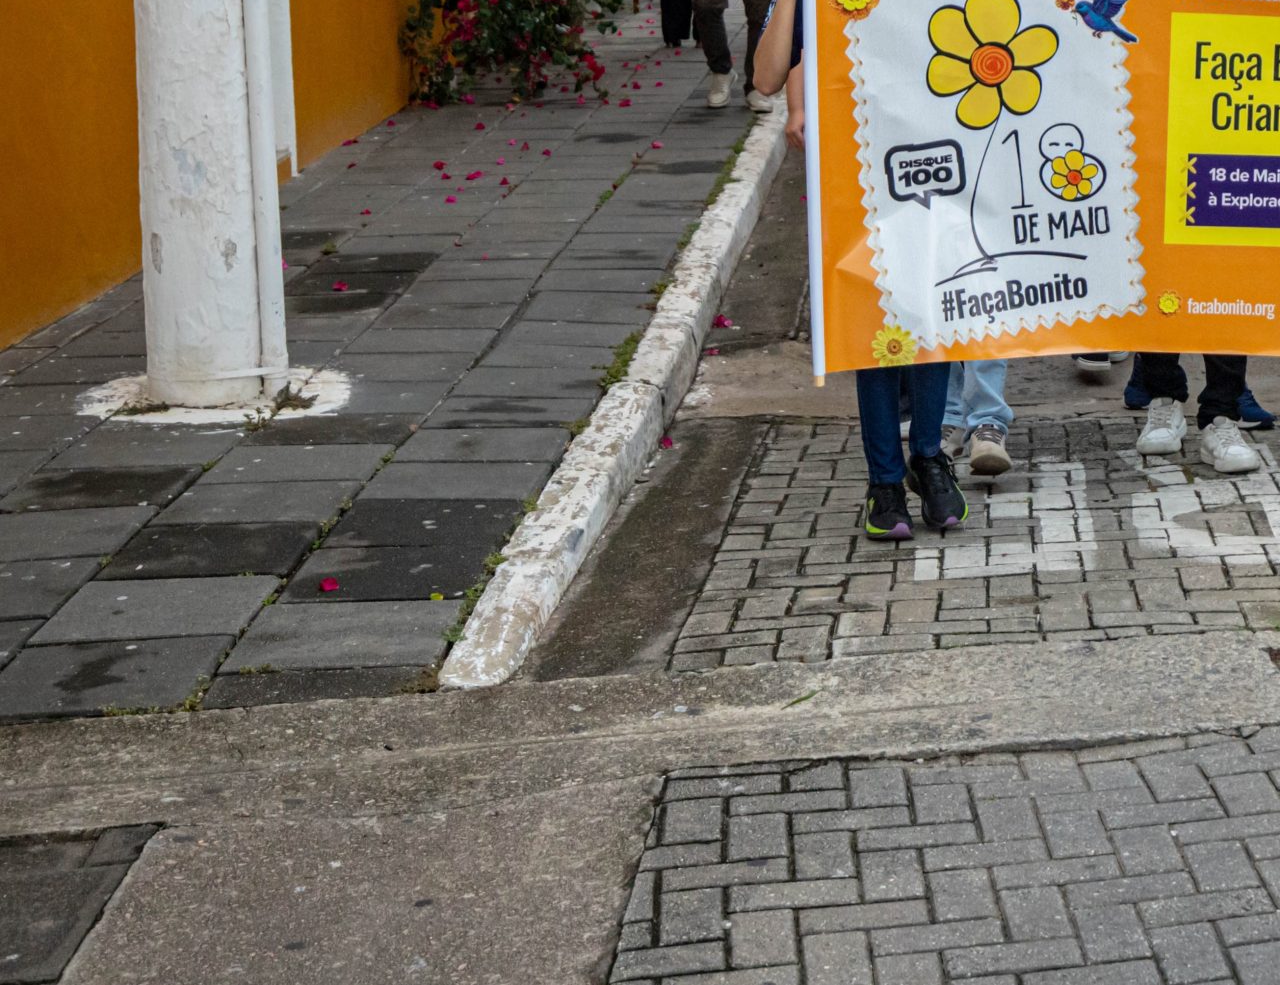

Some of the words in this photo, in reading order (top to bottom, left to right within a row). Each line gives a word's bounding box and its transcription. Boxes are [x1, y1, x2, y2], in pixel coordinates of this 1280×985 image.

[1194, 41, 1263, 91] Faça
[898, 154, 953, 169] DISQUE
[898, 166, 953, 187] 100
[1209, 168, 1227, 182] 18
[1229, 168, 1250, 183] de
[1208, 192, 1217, 206] à
[1012, 213, 1041, 245] DE
[1048, 206, 1111, 241] MAIO
[941, 273, 1088, 324] #FaçaBonito
[1187, 298, 1276, 320] facabonito.org
